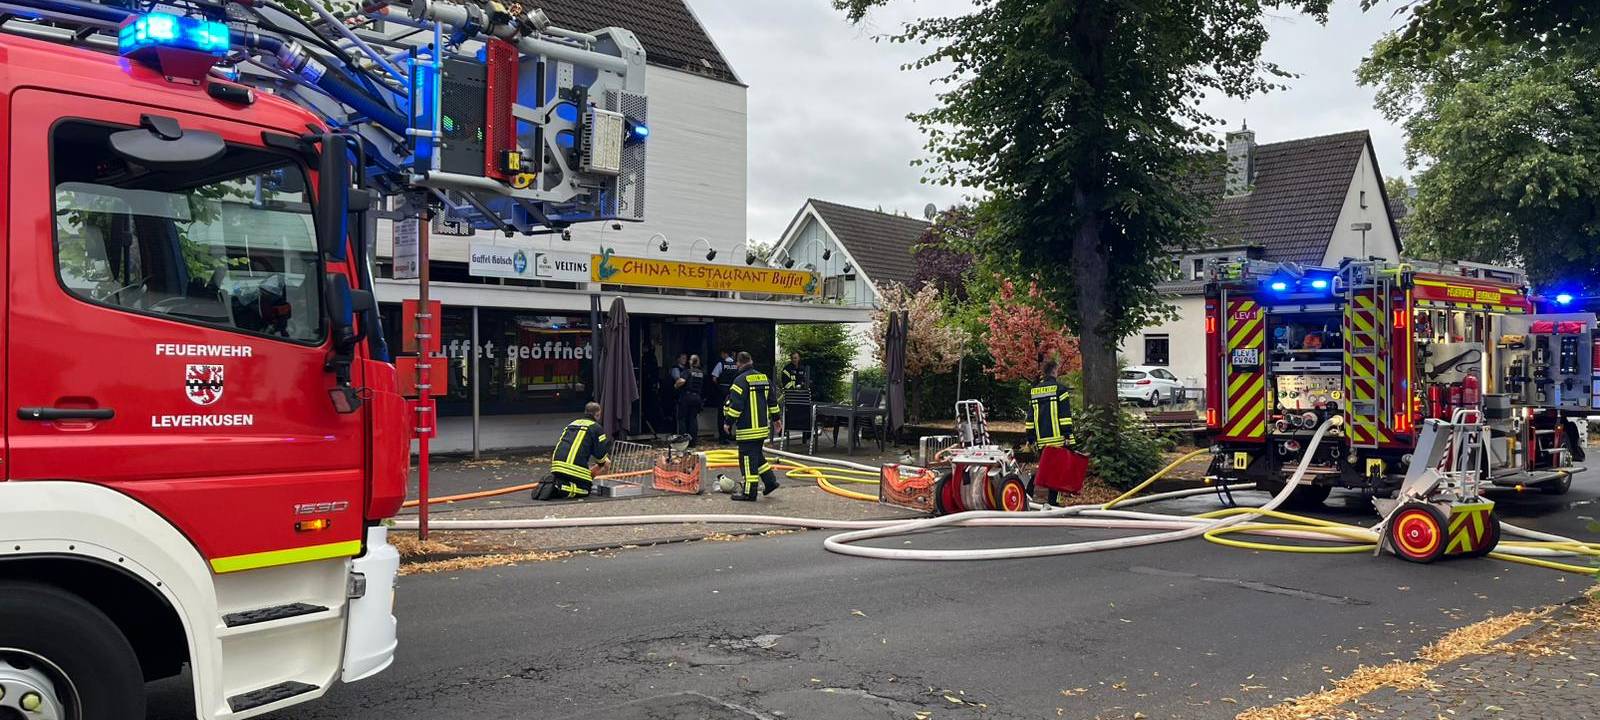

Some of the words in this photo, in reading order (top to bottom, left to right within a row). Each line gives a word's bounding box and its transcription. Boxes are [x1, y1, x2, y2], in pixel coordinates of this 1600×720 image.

[472, 253, 491, 264] Gaffel
[555, 260, 588, 273] VELTINS
[771, 271, 804, 288] Buffet
[1234, 311, 1250, 320] LEV
[1252, 311, 1257, 319] 1
[155, 343, 253, 357] FEUERWEHR
[507, 341, 593, 360] geöffnet
[151, 414, 254, 427] LEVERKUSEN
[294, 501, 349, 514] 1530
